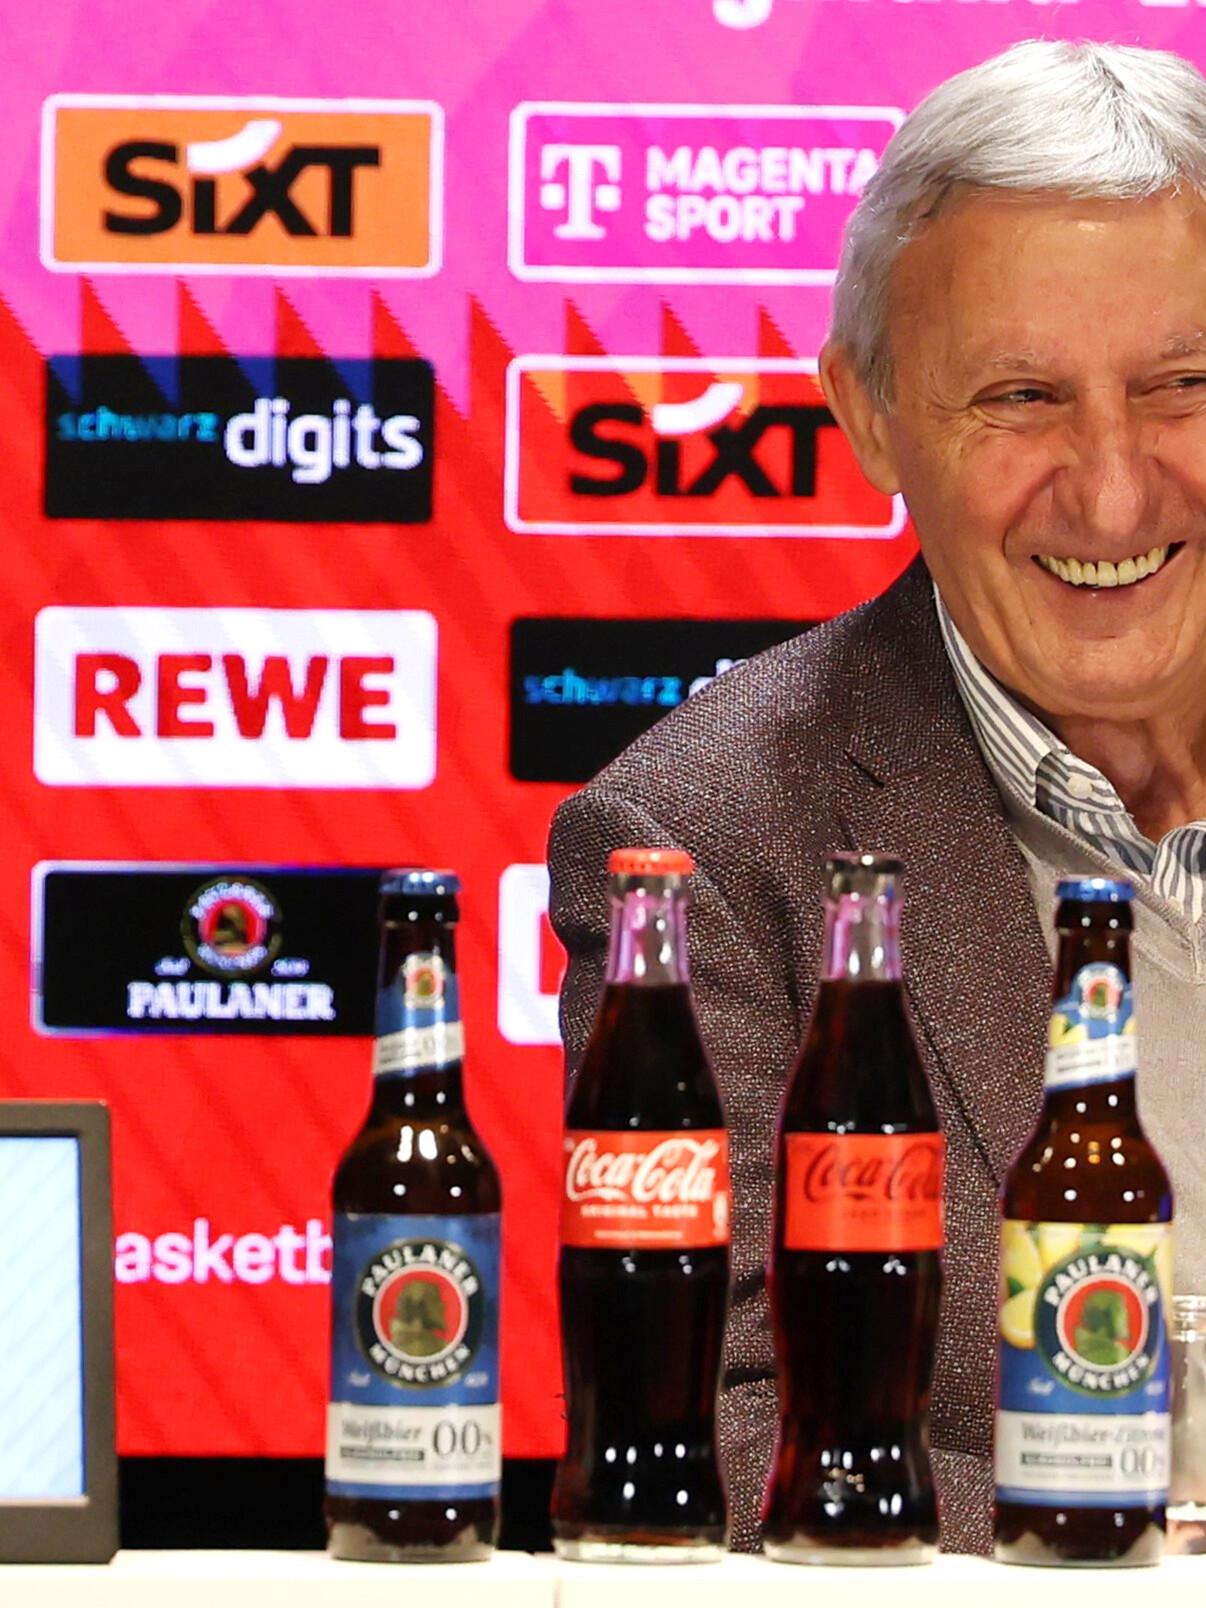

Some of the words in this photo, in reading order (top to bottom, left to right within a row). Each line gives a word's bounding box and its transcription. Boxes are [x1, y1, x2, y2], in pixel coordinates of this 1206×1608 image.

[645, 145, 880, 194] MAGENTA
[645, 194, 805, 242] SPORT
[224, 398, 424, 484] digits
[74, 653, 397, 741] REWE
[127, 981, 337, 1021] PAULANER
[565, 1138, 720, 1203] Coca-Cola
[361, 1243, 479, 1298] PAULANER
[1043, 1253, 1158, 1307] PAULANER
